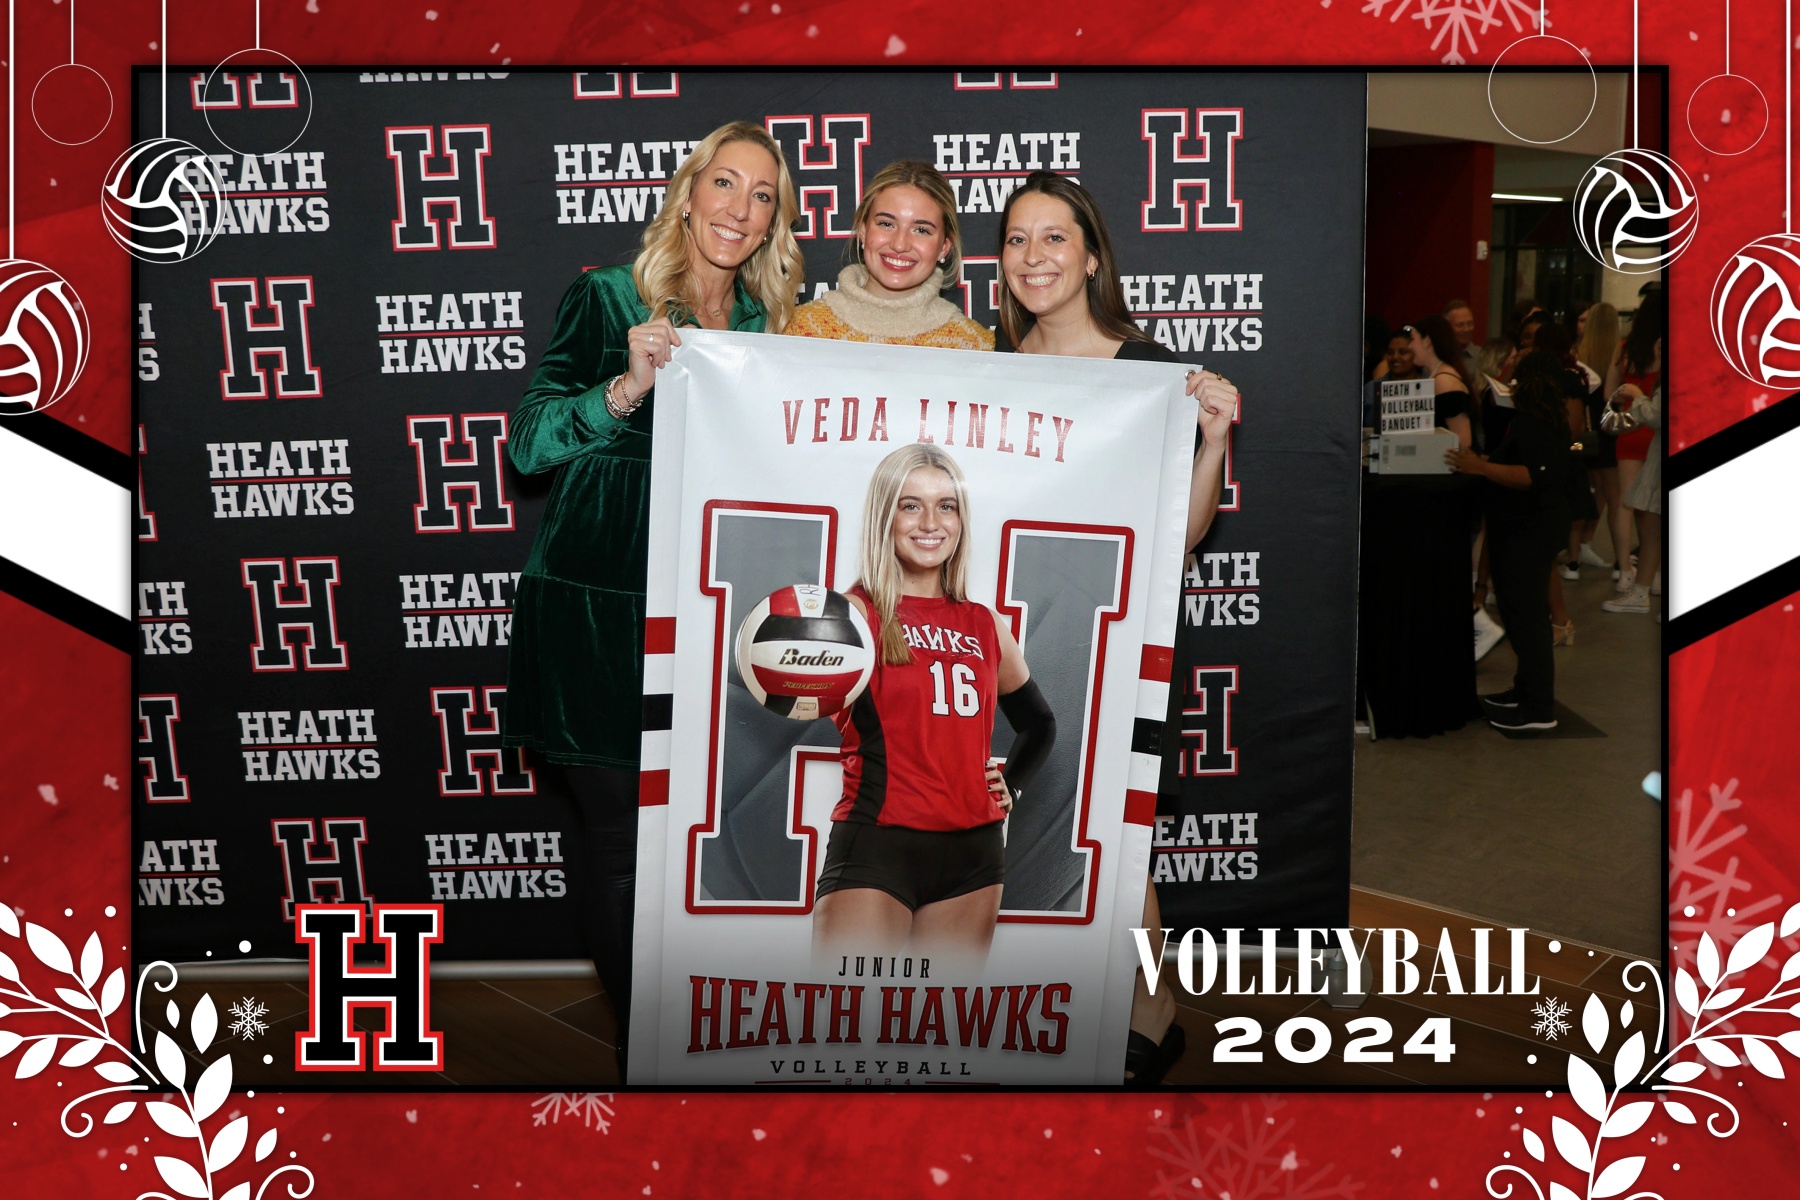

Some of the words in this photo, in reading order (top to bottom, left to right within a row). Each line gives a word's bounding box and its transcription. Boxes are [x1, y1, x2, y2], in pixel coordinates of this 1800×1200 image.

[933, 132, 1081, 171] HEATH
[175, 152, 327, 193] HEATH
[385, 123, 497, 251] H
[1141, 108, 1244, 232] H
[180, 197, 330, 235] HAWKS
[556, 187, 667, 224] HAW
[1120, 274, 1263, 311] HEATH
[375, 291, 524, 332] HEATH
[210, 275, 323, 400] H
[1135, 317, 1263, 352] AWKS
[379, 336, 526, 374] HAWKS
[1382, 399, 1434, 414] VOLLEYBALL
[1383, 383, 1410, 397] HEATH
[782, 396, 890, 445] VEDA
[916, 398, 1074, 463] LINLEY
[1382, 416, 1421, 431] BANQUET
[206, 439, 351, 478] HEATH
[406, 412, 515, 533] H
[211, 482, 354, 518] HAWKS
[1184, 552, 1260, 587] ATH
[240, 556, 349, 672] H
[403, 614, 513, 648] HAWK
[778, 648, 844, 666] Baden
[929, 660, 981, 718] 16
[237, 709, 377, 744] HEATH
[430, 686, 536, 797] H
[242, 749, 381, 781] HAWKS
[1153, 812, 1258, 847] EATH
[139, 839, 220, 872] ATH
[425, 831, 564, 865] HEATH
[429, 869, 567, 900] HAWKS
[1152, 851, 1258, 883] AWKS
[139, 877, 225, 906] WKS
[838, 956, 931, 979] JUNIOR
[686, 975, 865, 1054] HEATH
[877, 982, 1073, 1056] HAWKS
[770, 1060, 971, 1076] VOLLEYBALL
